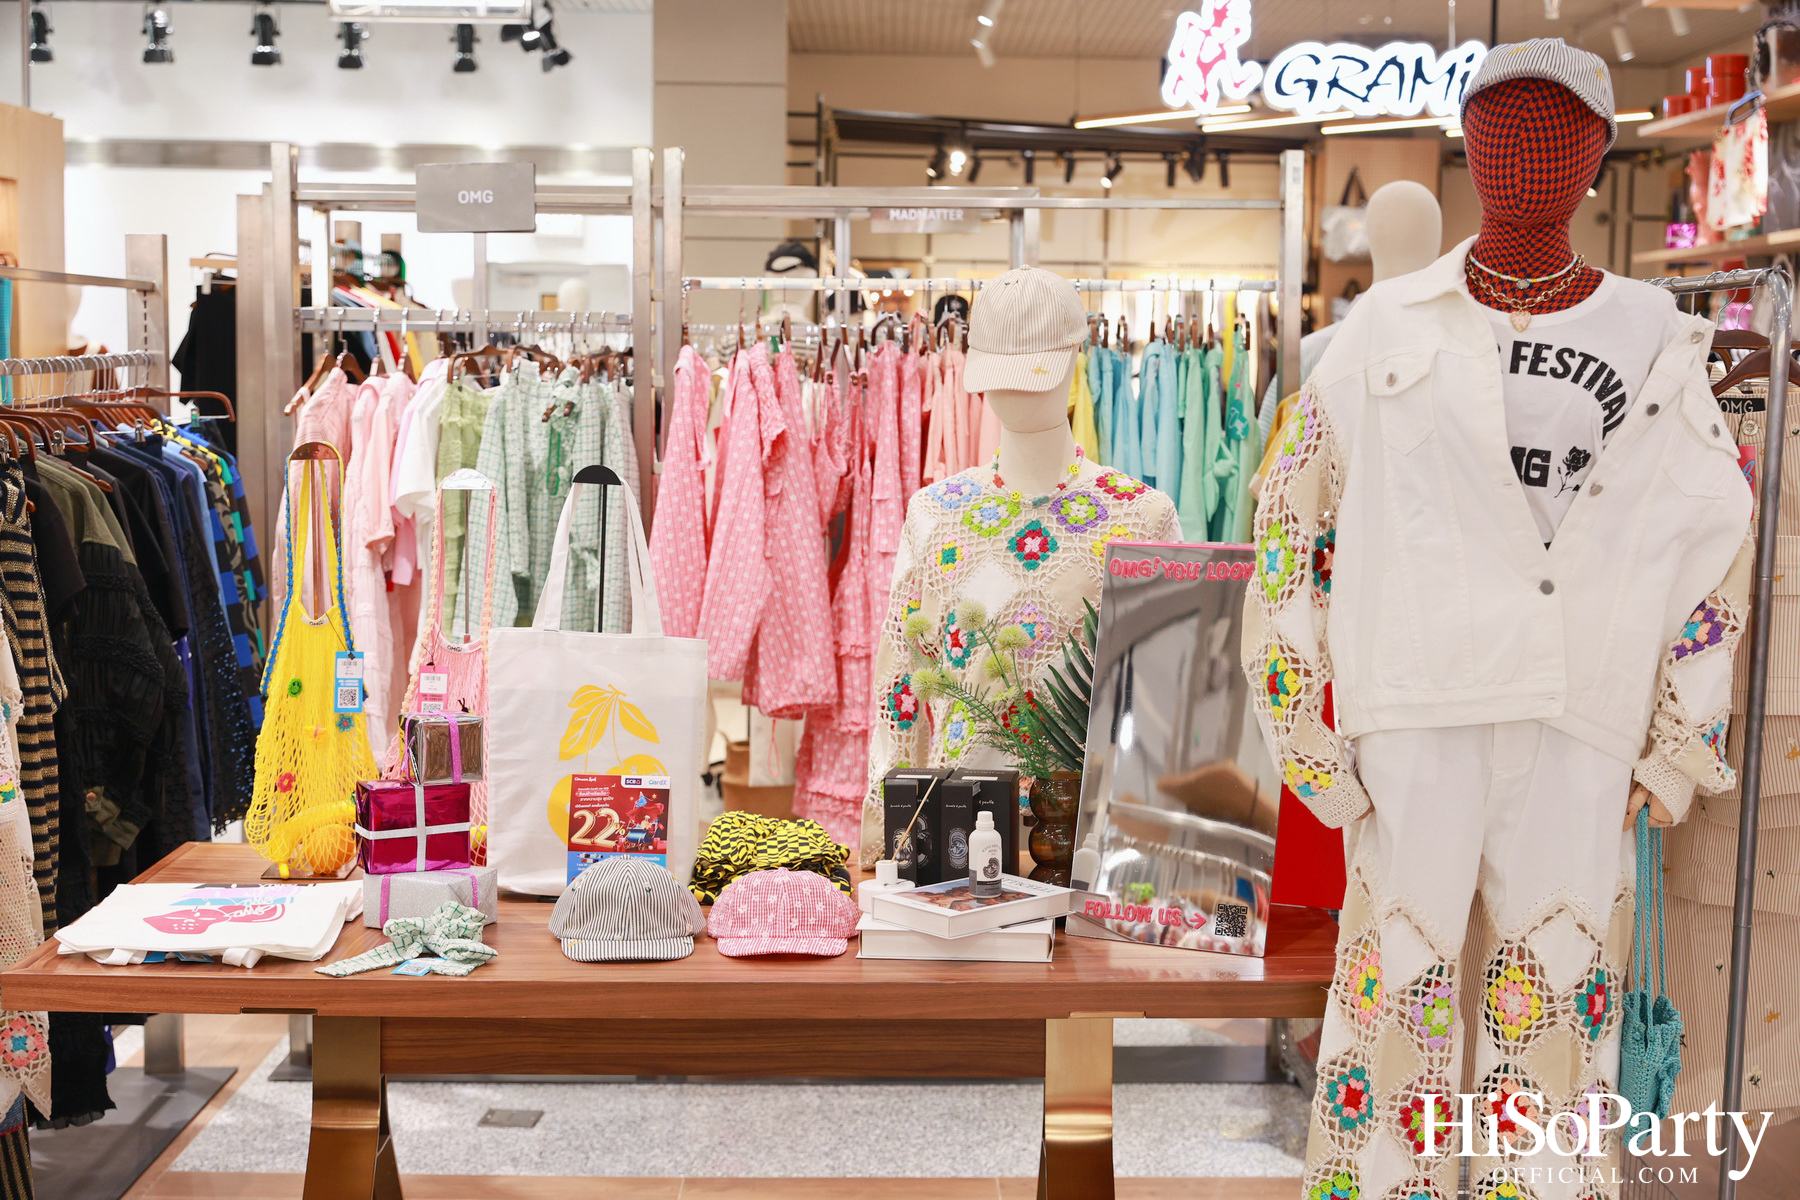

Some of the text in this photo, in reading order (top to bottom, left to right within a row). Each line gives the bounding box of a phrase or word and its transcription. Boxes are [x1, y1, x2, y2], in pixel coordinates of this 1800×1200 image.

[457, 190, 494, 205] OMG
[1719, 399, 1754, 414] OMG
[1161, 560, 1201, 582] YOU
[1205, 561, 1257, 582] LOOK
[1083, 900, 1183, 927] FOLLOW US
